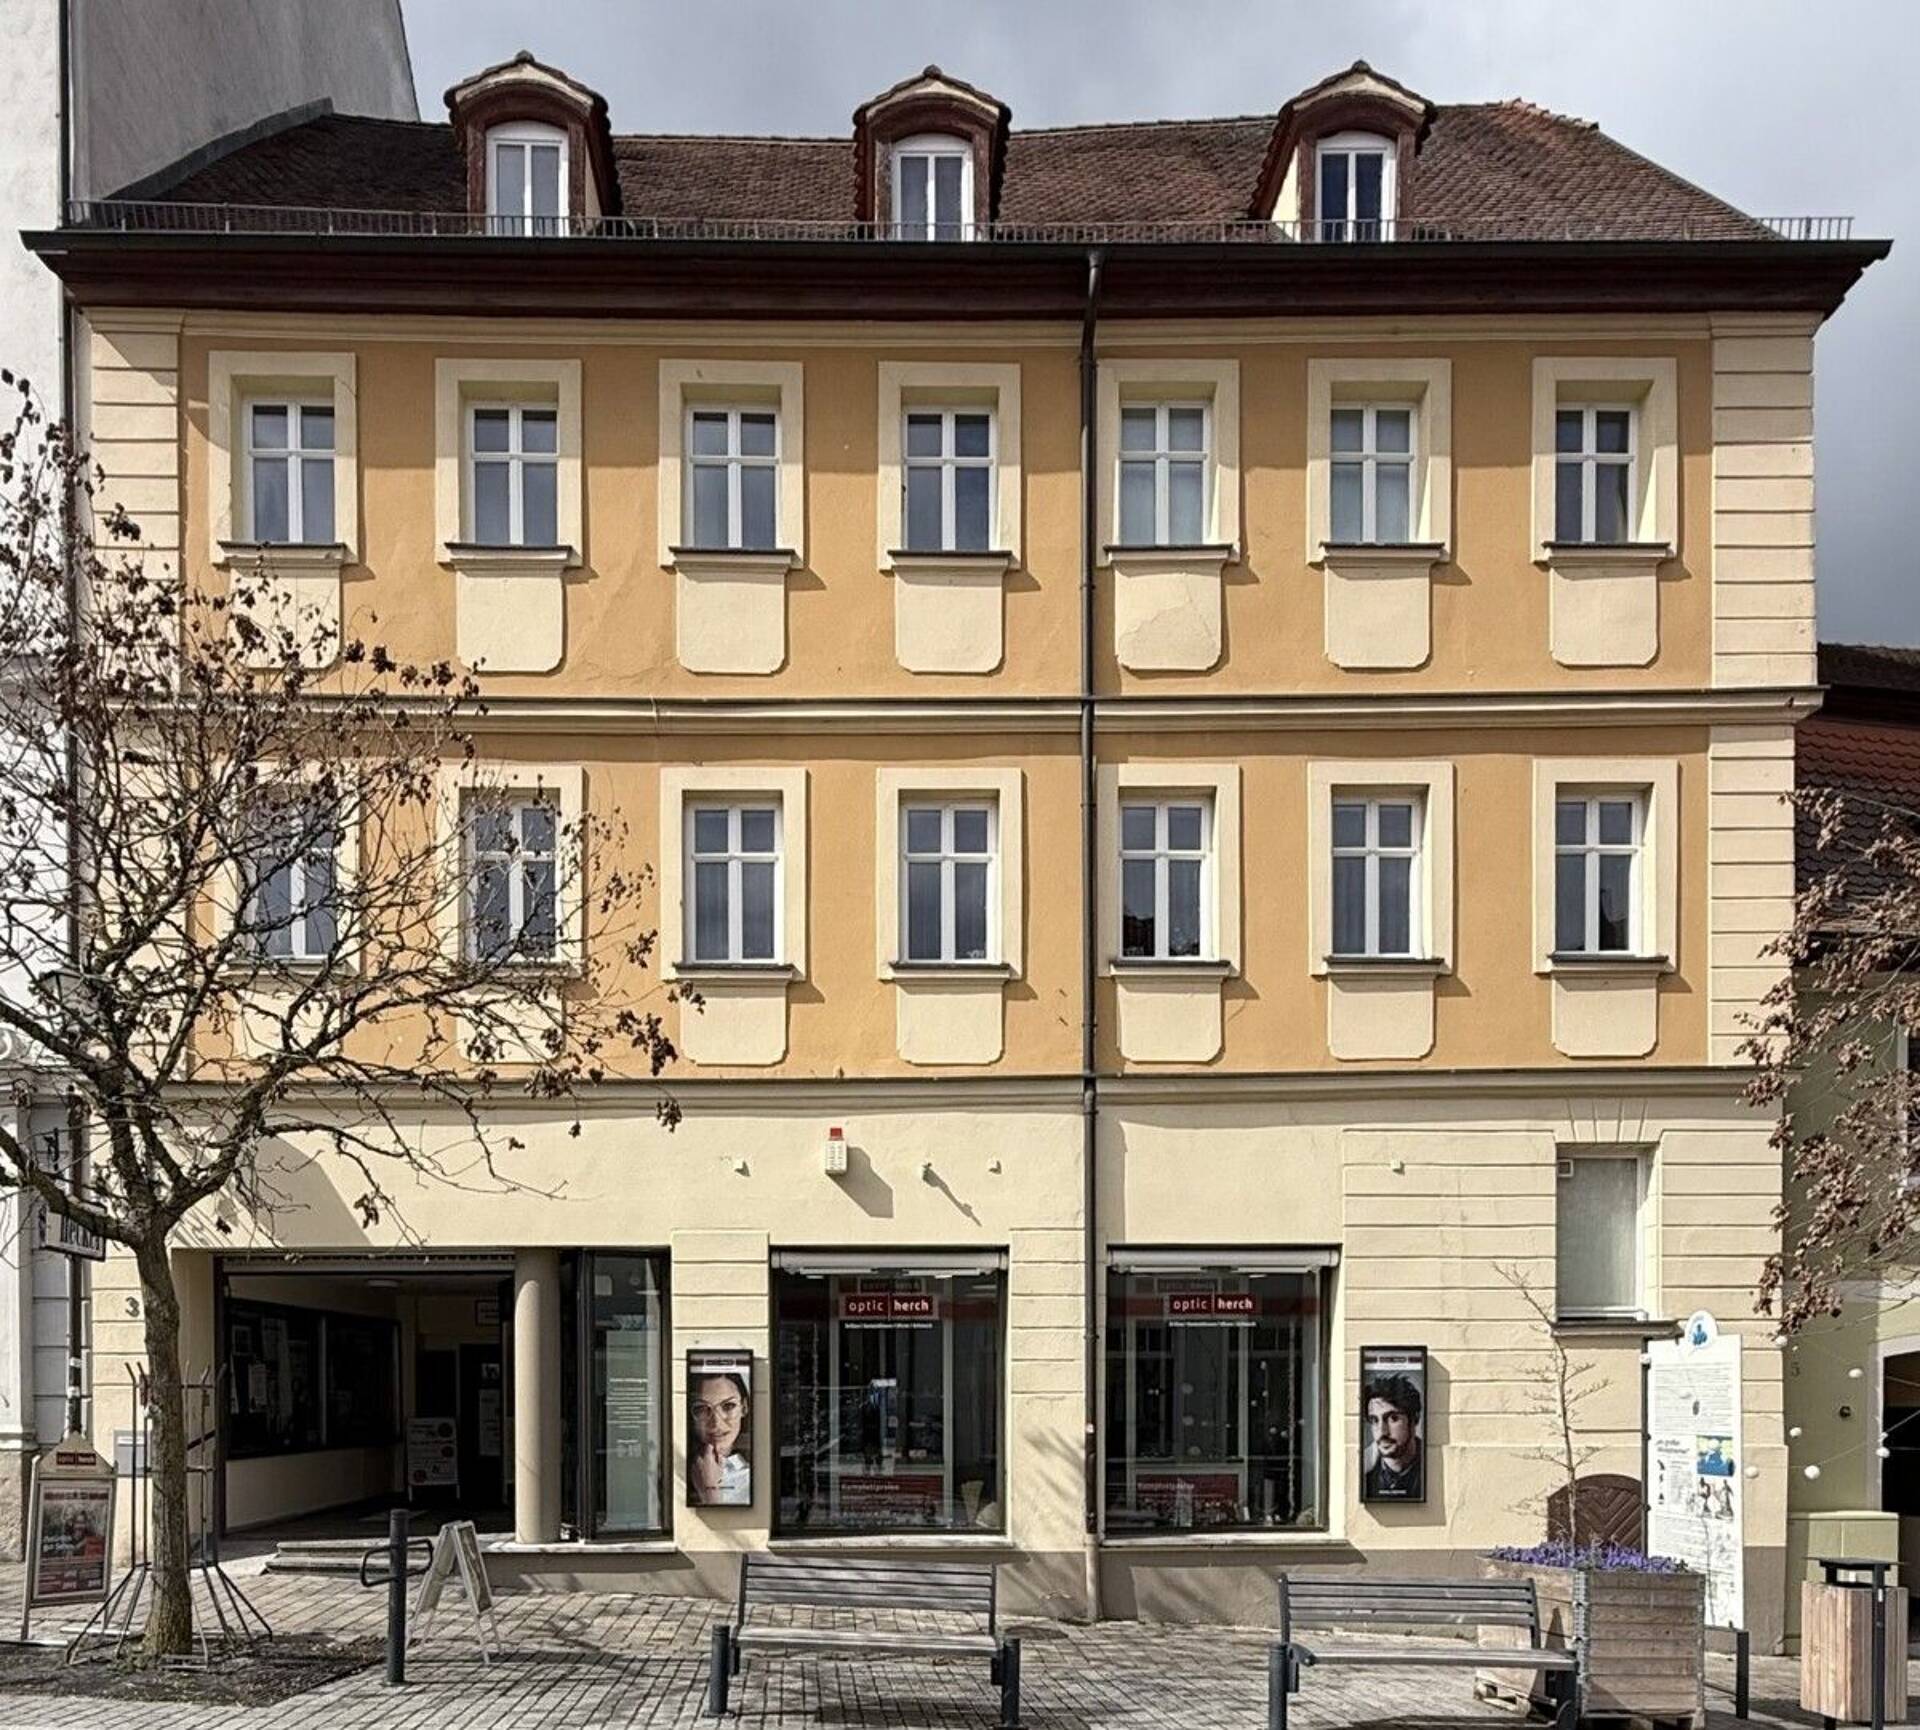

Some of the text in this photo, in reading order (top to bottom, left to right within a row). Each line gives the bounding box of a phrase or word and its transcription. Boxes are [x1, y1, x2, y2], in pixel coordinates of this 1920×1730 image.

[126, 1296, 140, 1317] 3
[848, 1299, 929, 1313] optic herch
[1173, 1297, 1253, 1312] optic herch
